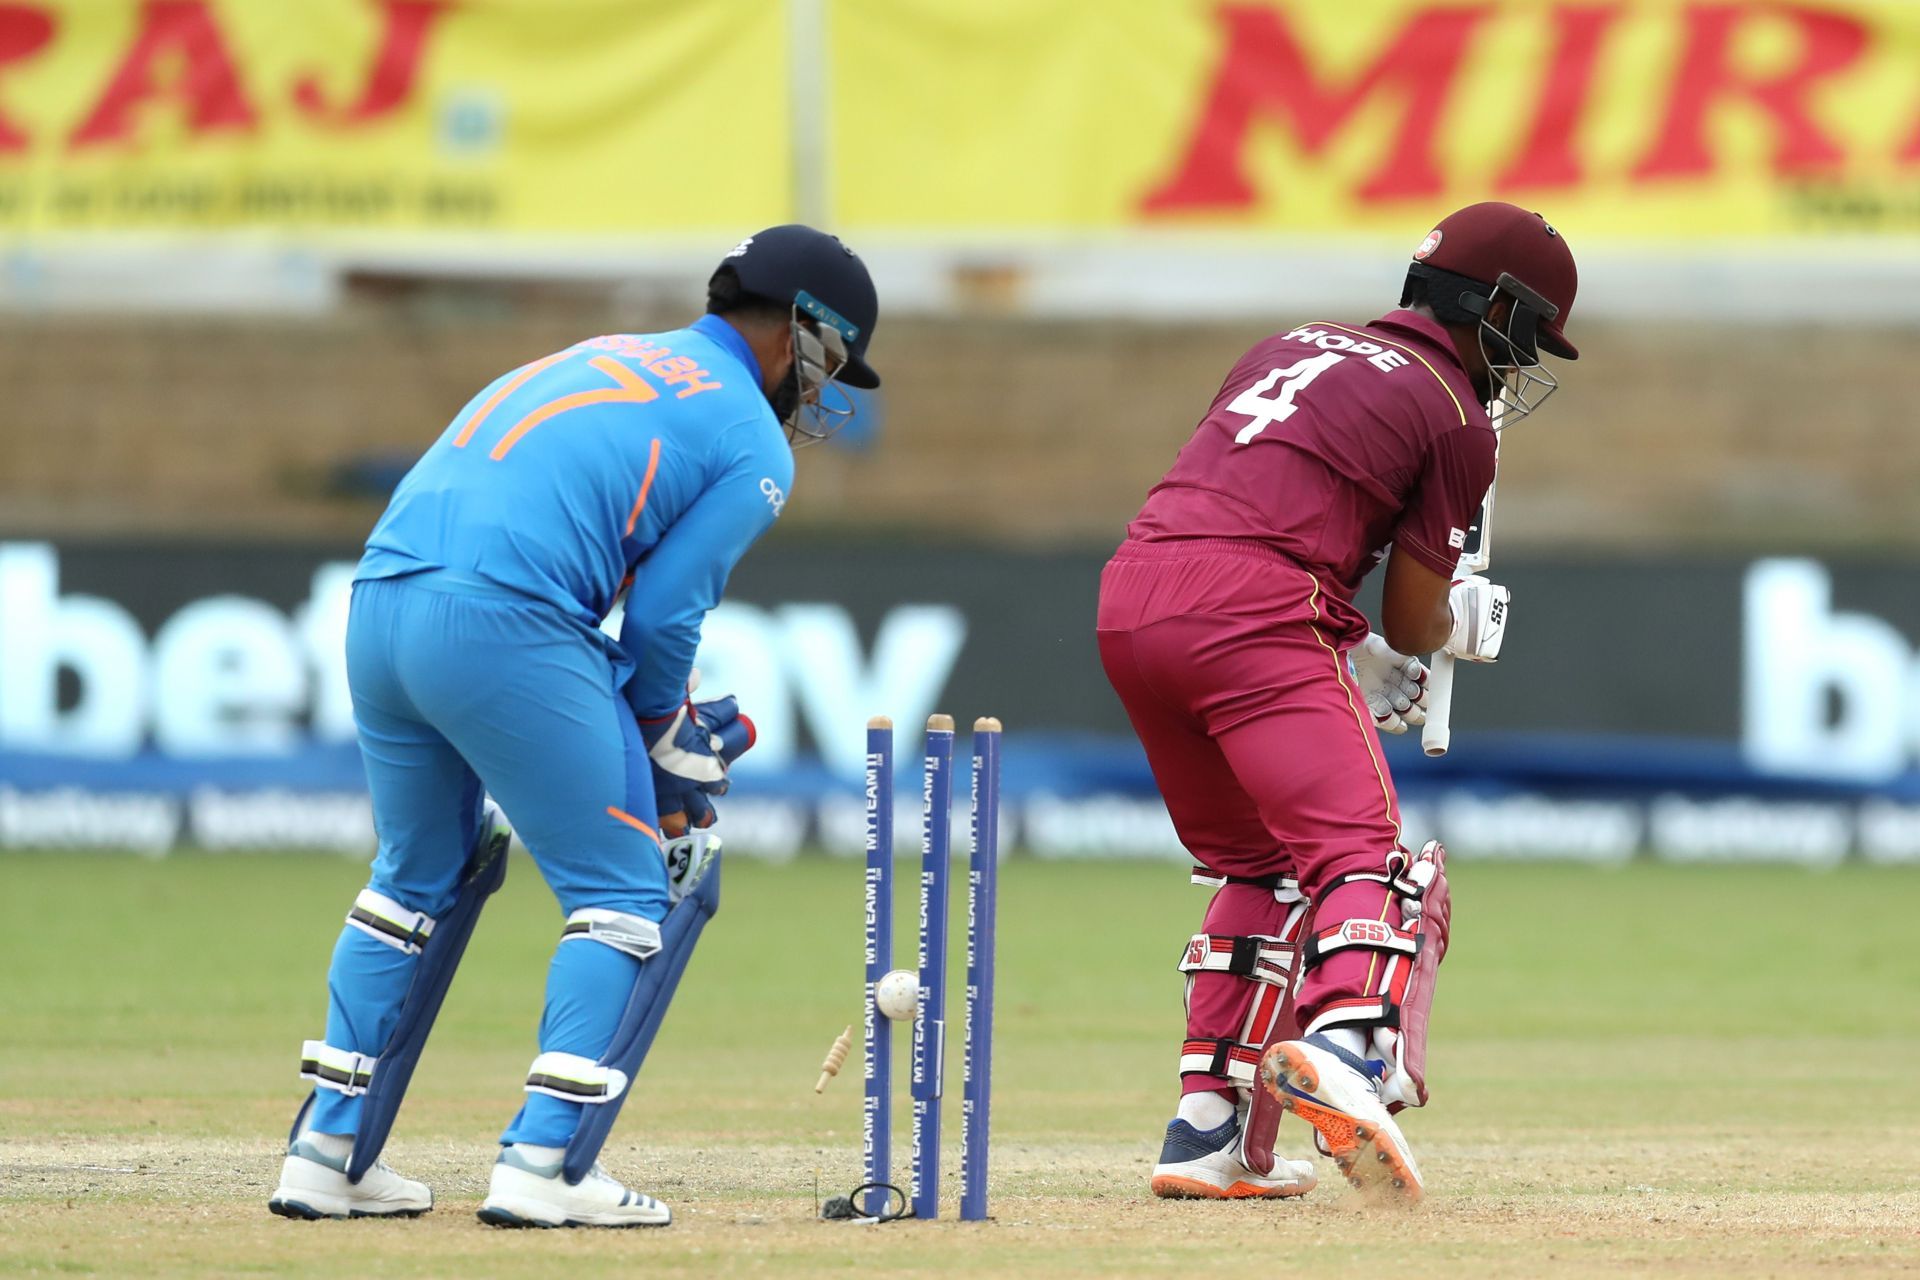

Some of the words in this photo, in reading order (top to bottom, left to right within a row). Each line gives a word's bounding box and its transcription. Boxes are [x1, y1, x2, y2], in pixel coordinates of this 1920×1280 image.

[1138, 0, 1920, 214] MIR
[1281, 328, 1410, 373] HOPE
[452, 349, 660, 461] 17
[1225, 351, 1347, 444] 4
[760, 477, 785, 517] op
[1490, 598, 1504, 626] SS
[1187, 939, 1205, 964] SS
[1349, 923, 1385, 941] SS
